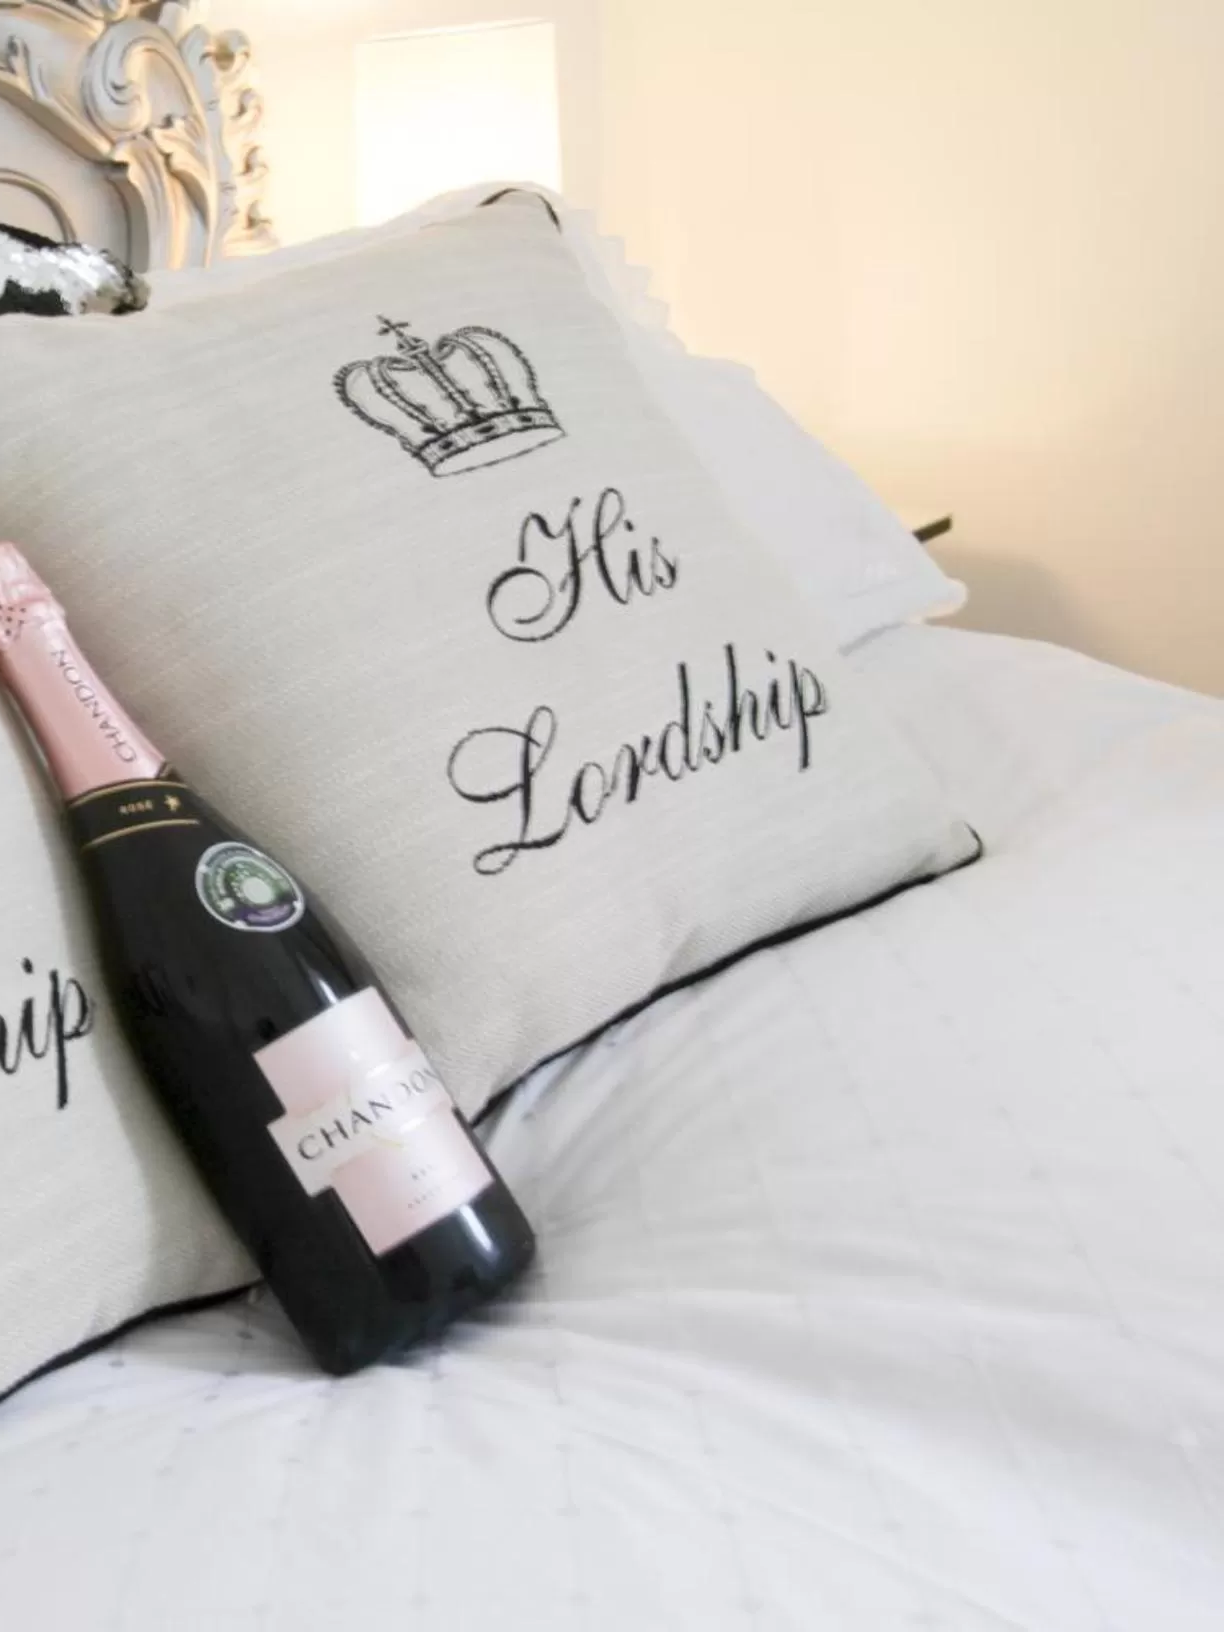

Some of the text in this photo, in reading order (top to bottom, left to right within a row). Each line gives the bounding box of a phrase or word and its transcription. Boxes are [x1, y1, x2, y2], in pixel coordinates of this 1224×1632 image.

[486, 486, 678, 642] His
[51, 649, 137, 764] CHANDON
[447, 642, 829, 876] Lordship
